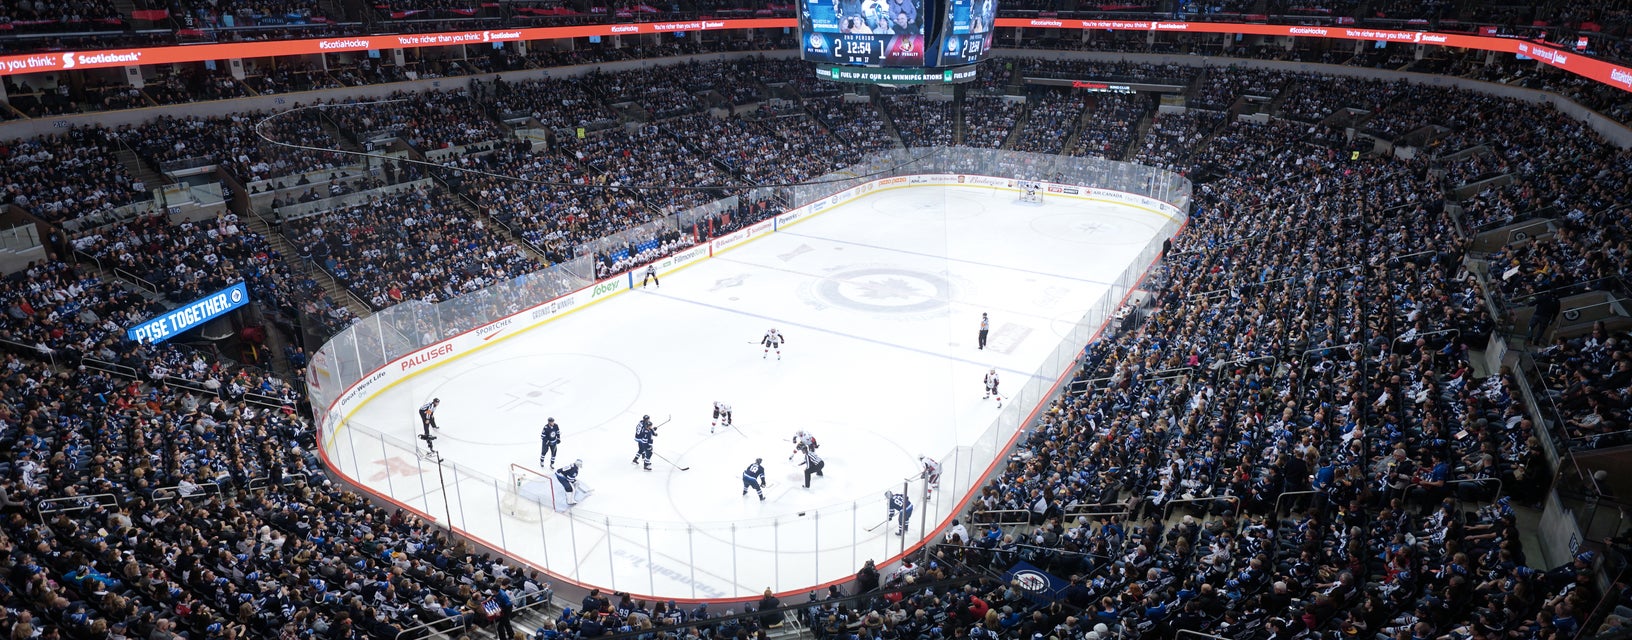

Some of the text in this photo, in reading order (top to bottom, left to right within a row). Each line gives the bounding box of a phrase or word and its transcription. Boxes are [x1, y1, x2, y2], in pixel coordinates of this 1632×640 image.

[398, 37, 418, 45] You're
[452, 35, 464, 43] you
[491, 31, 520, 40] Scotiabank
[1289, 27, 1328, 36] #ScotiaHockey
[1387, 32, 1397, 40] you
[319, 39, 369, 49] #ScotiaHockey
[834, 38, 842, 58] 2
[847, 41, 871, 55] 12:54
[878, 39, 886, 59] 1
[961, 39, 968, 58] 2
[8, 61, 26, 72] you
[79, 52, 139, 65] Scotiabank
[891, 177, 907, 185] pizza
[1102, 190, 1123, 199] CANADA
[591, 279, 620, 298] Sobeys
[168, 293, 232, 332] TOGETHER.
[475, 317, 513, 336] SPORTCHEK
[400, 343, 453, 371] PALLISER
[341, 371, 387, 406] Great-West Life
[619, 608, 630, 618] 99
